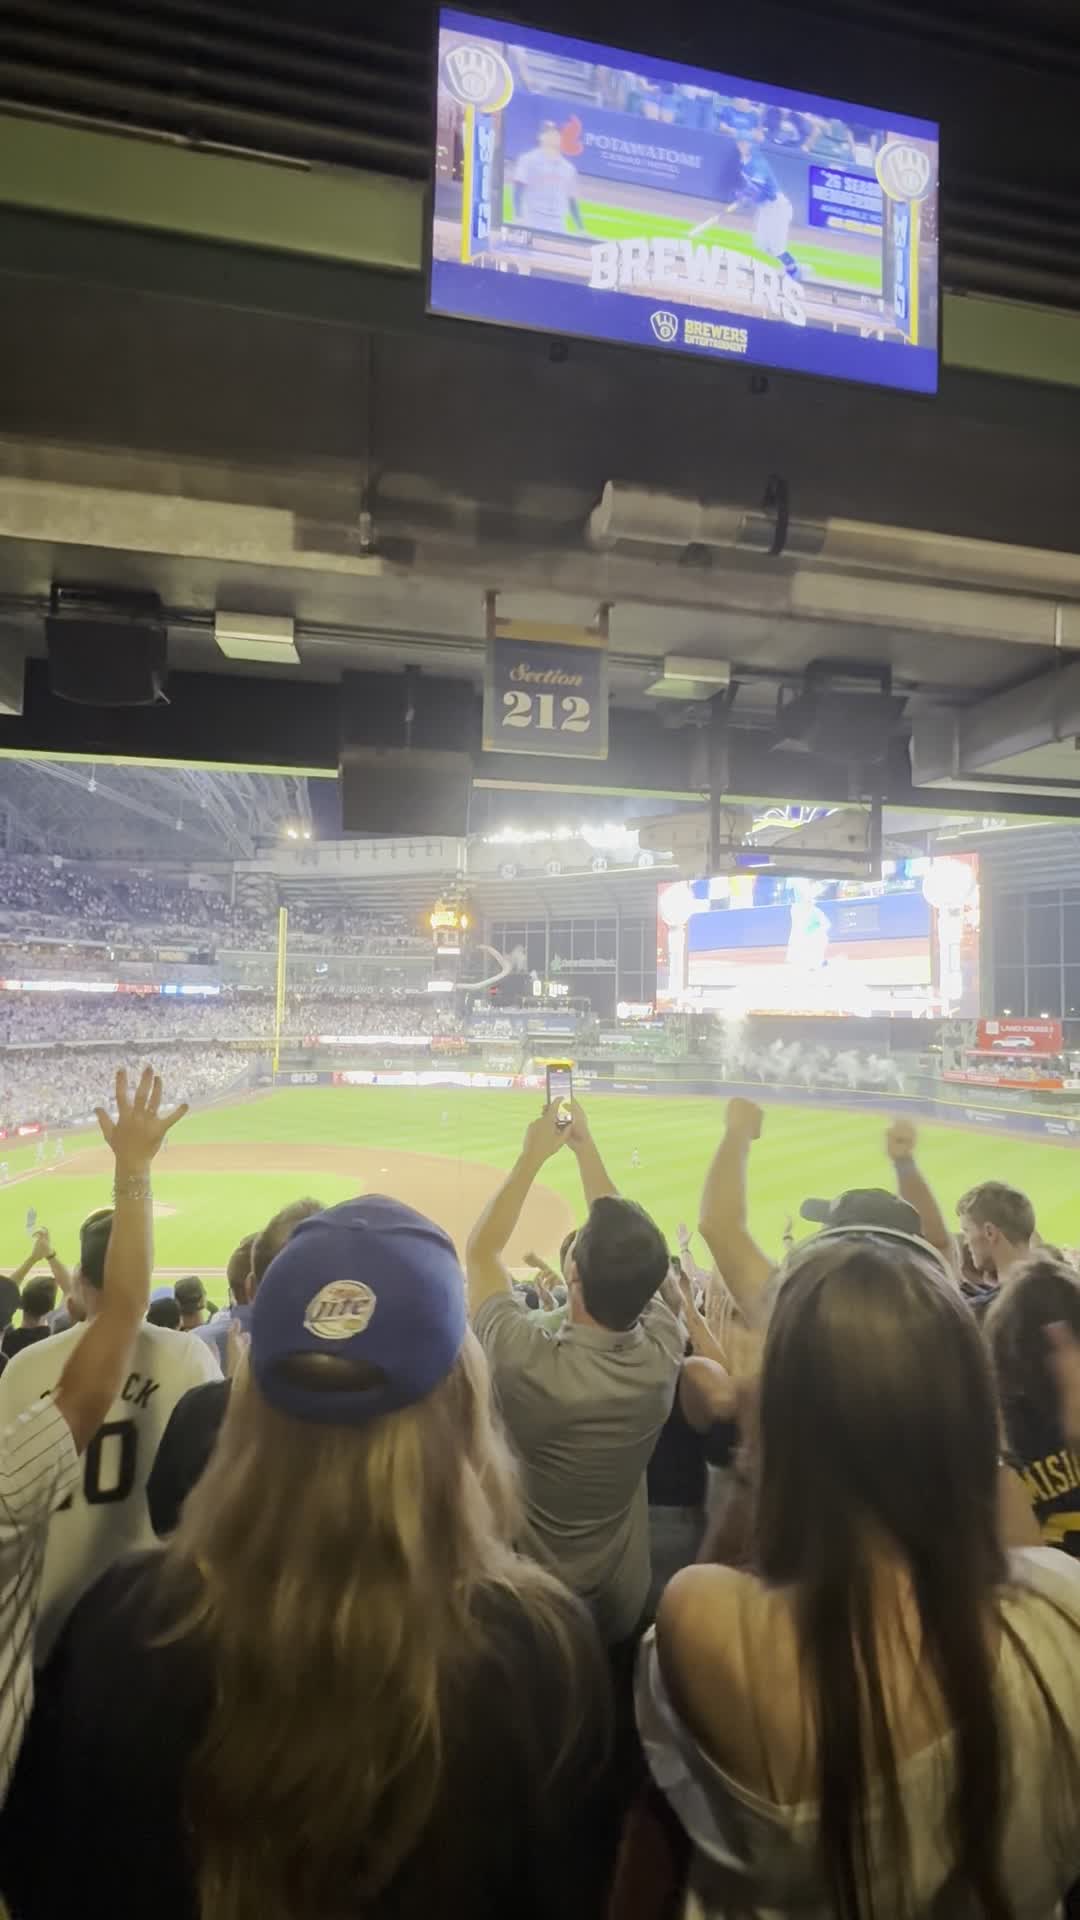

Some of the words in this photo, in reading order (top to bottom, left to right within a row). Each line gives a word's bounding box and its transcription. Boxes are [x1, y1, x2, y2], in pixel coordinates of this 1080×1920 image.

[589, 238, 806, 327] BREWERS
[684, 319, 748, 343] BREWERS
[510, 663, 583, 687] Section
[502, 690, 591, 732] 212
[70, 1419, 138, 1507] 0
